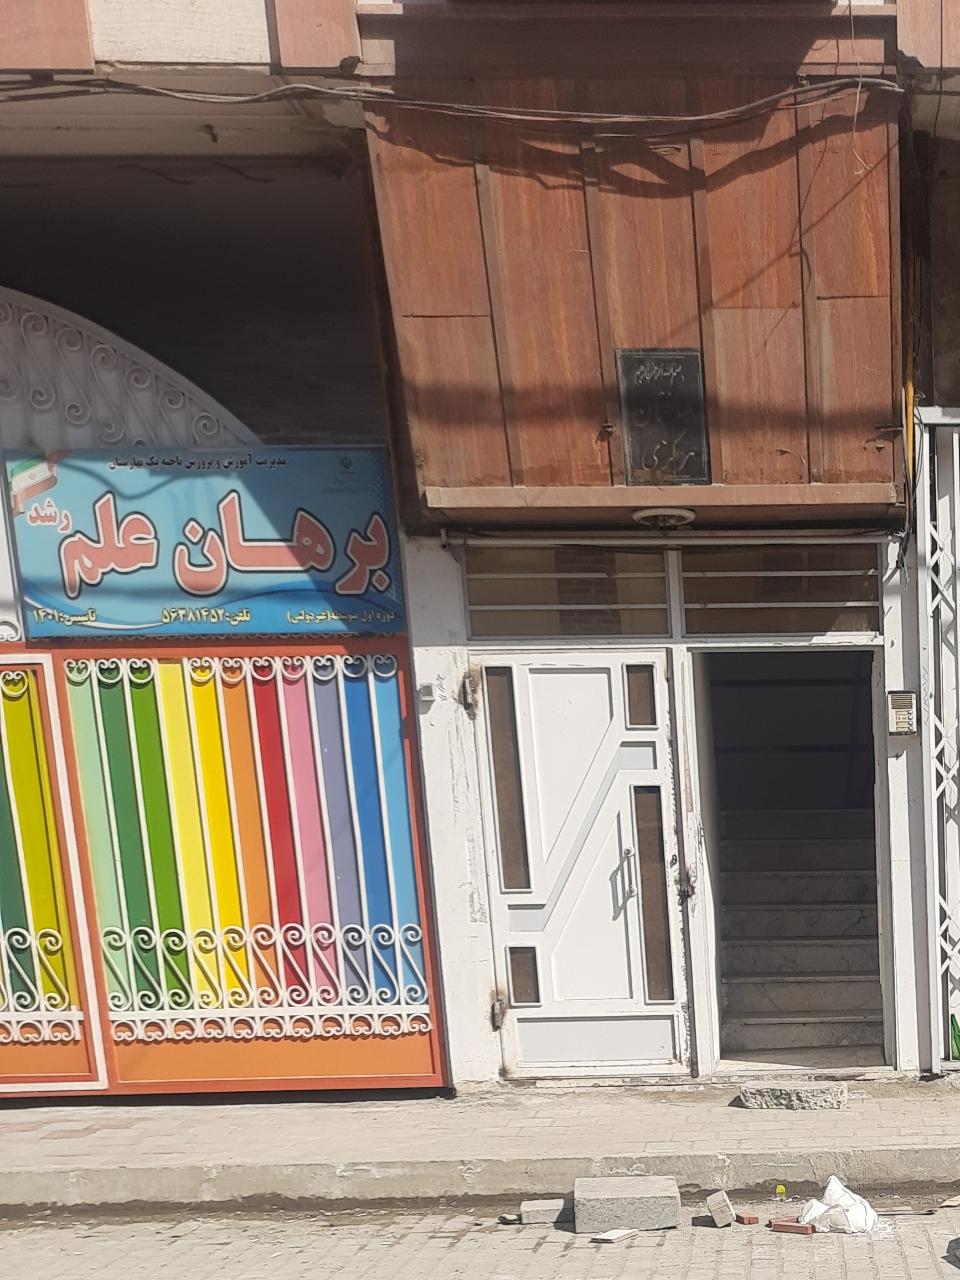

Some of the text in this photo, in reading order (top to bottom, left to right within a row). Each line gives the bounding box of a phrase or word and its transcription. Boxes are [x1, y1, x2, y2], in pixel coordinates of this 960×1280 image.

[108, 453, 288, 470] مدیریت آموزش و پرورش ناحیه یک بهارستان
[27, 490, 391, 599] برهان علم رشد
